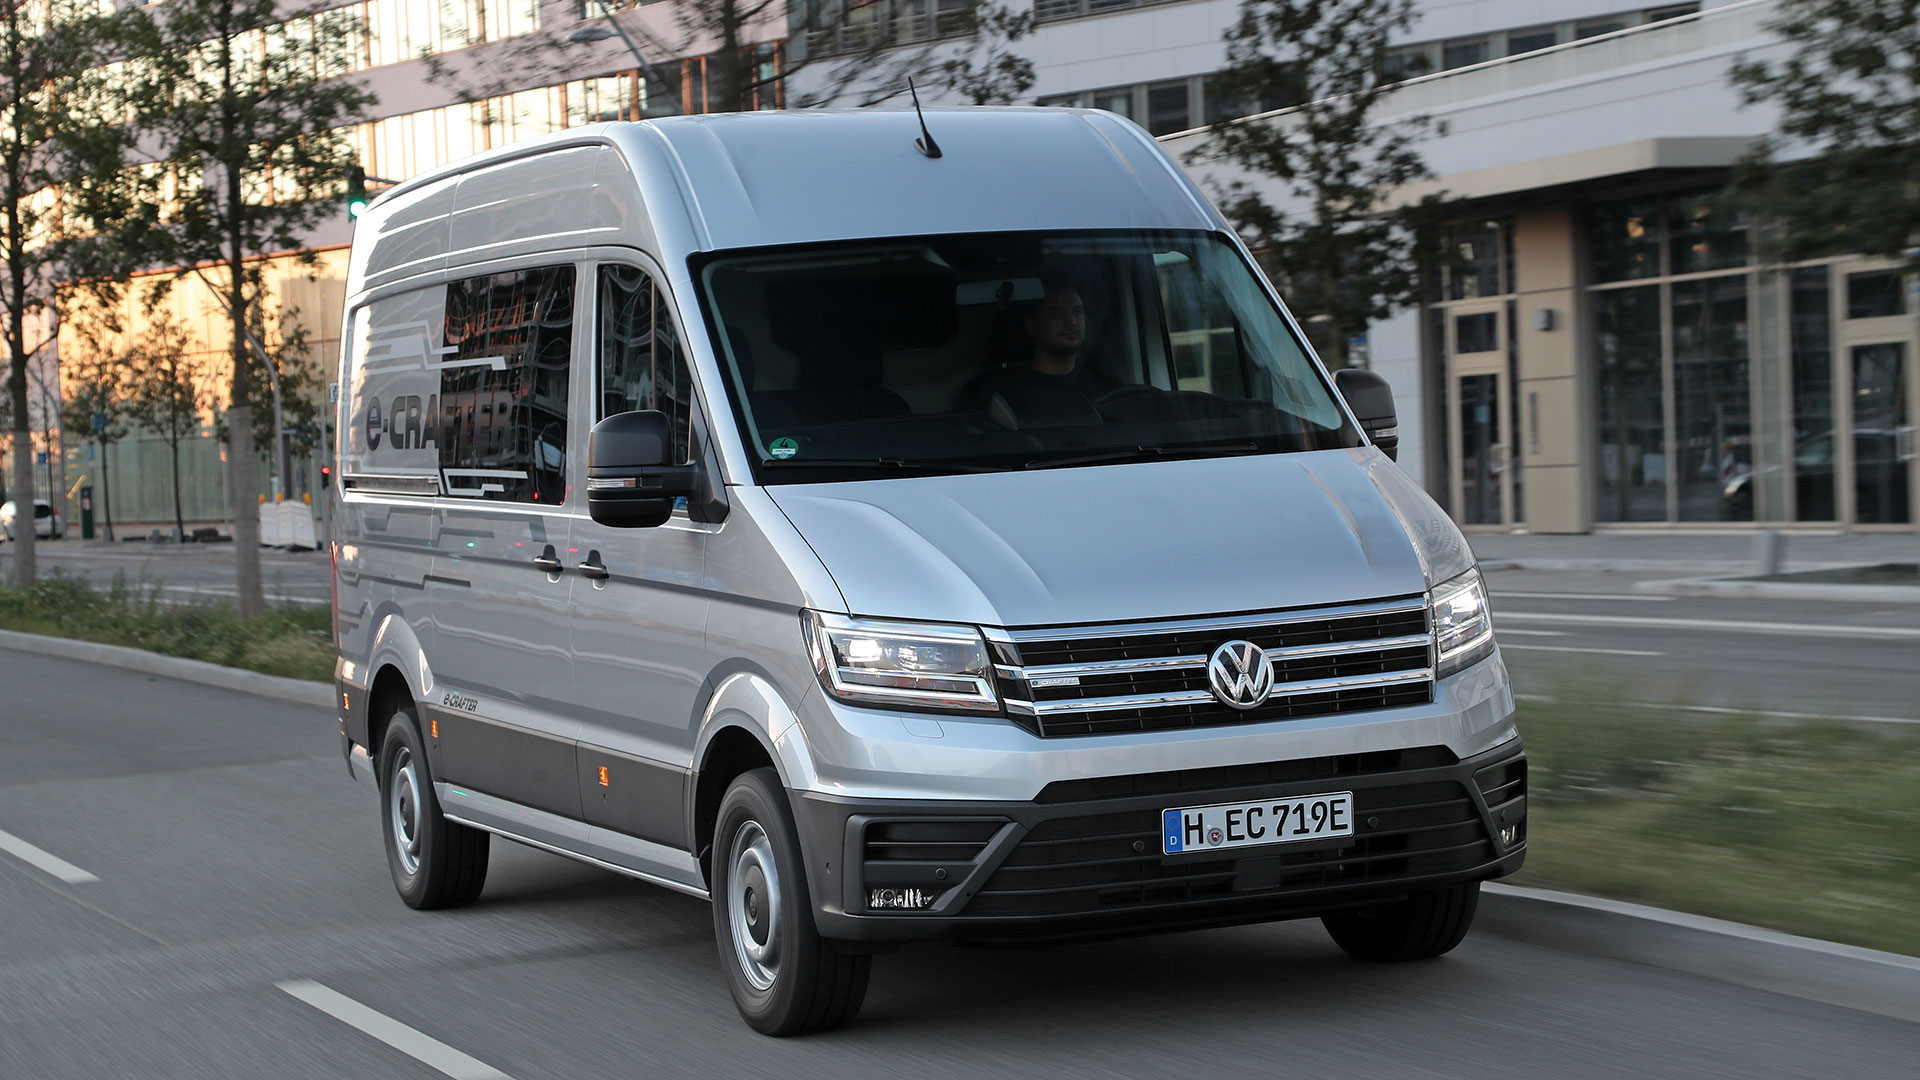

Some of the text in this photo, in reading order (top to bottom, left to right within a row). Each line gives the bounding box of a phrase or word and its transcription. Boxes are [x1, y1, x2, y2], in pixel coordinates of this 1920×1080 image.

[366, 393, 514, 452] e-CRAFTER
[780, 438, 788, 449] 4
[1209, 640, 1274, 708] VW
[443, 694, 478, 712] e-CRAFTER
[1184, 798, 1348, 846] H EC 719E
[1170, 836, 1178, 846] D
